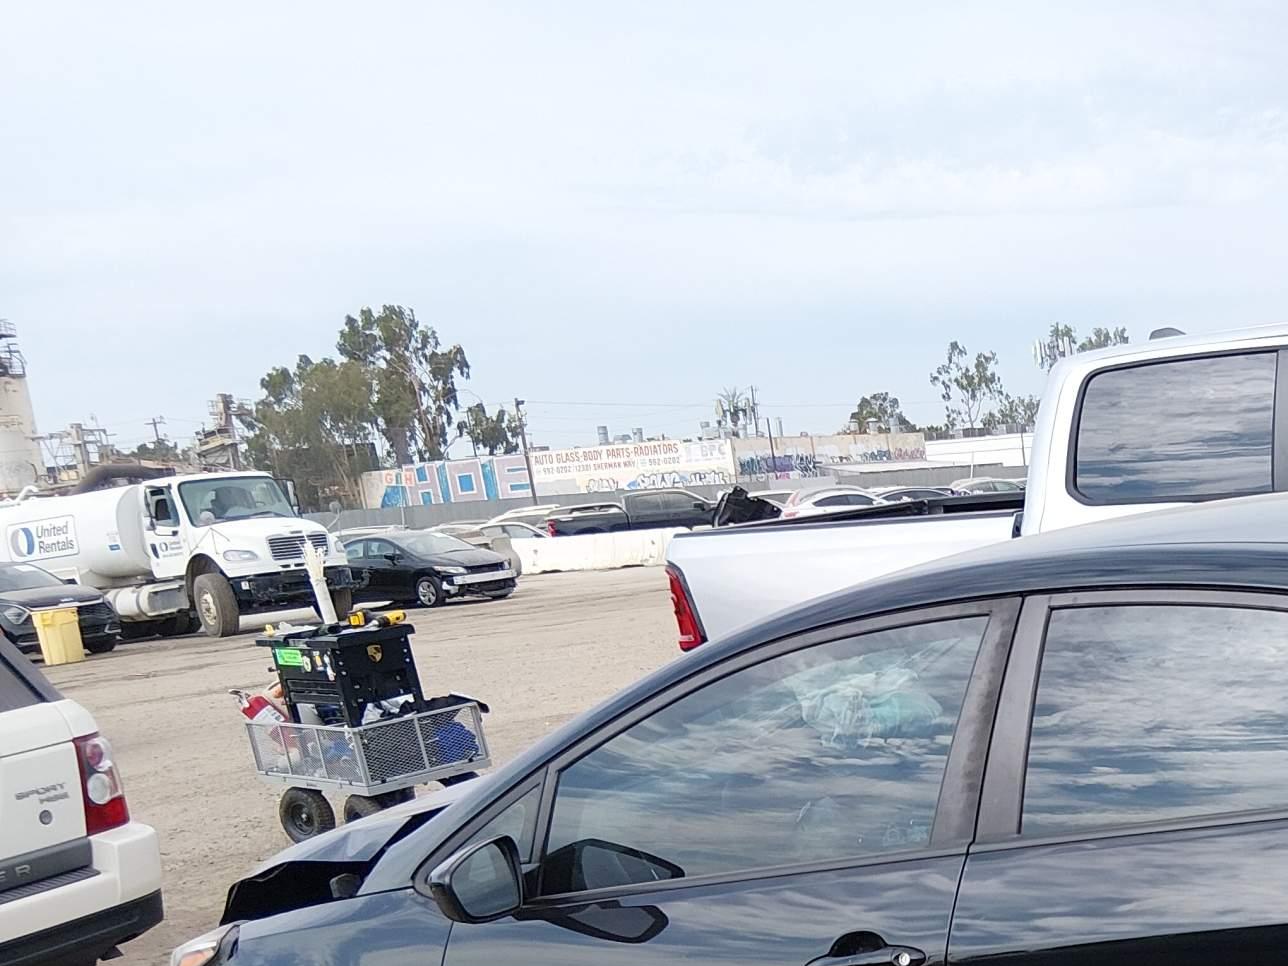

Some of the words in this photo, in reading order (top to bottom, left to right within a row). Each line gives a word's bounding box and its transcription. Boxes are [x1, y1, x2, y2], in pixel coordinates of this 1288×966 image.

[534, 454, 554, 466] AUTO
[623, 460, 636, 468] WAY
[35, 520, 69, 539] United
[38, 536, 75, 555] Rentals
[15, 782, 66, 800] SPORT
